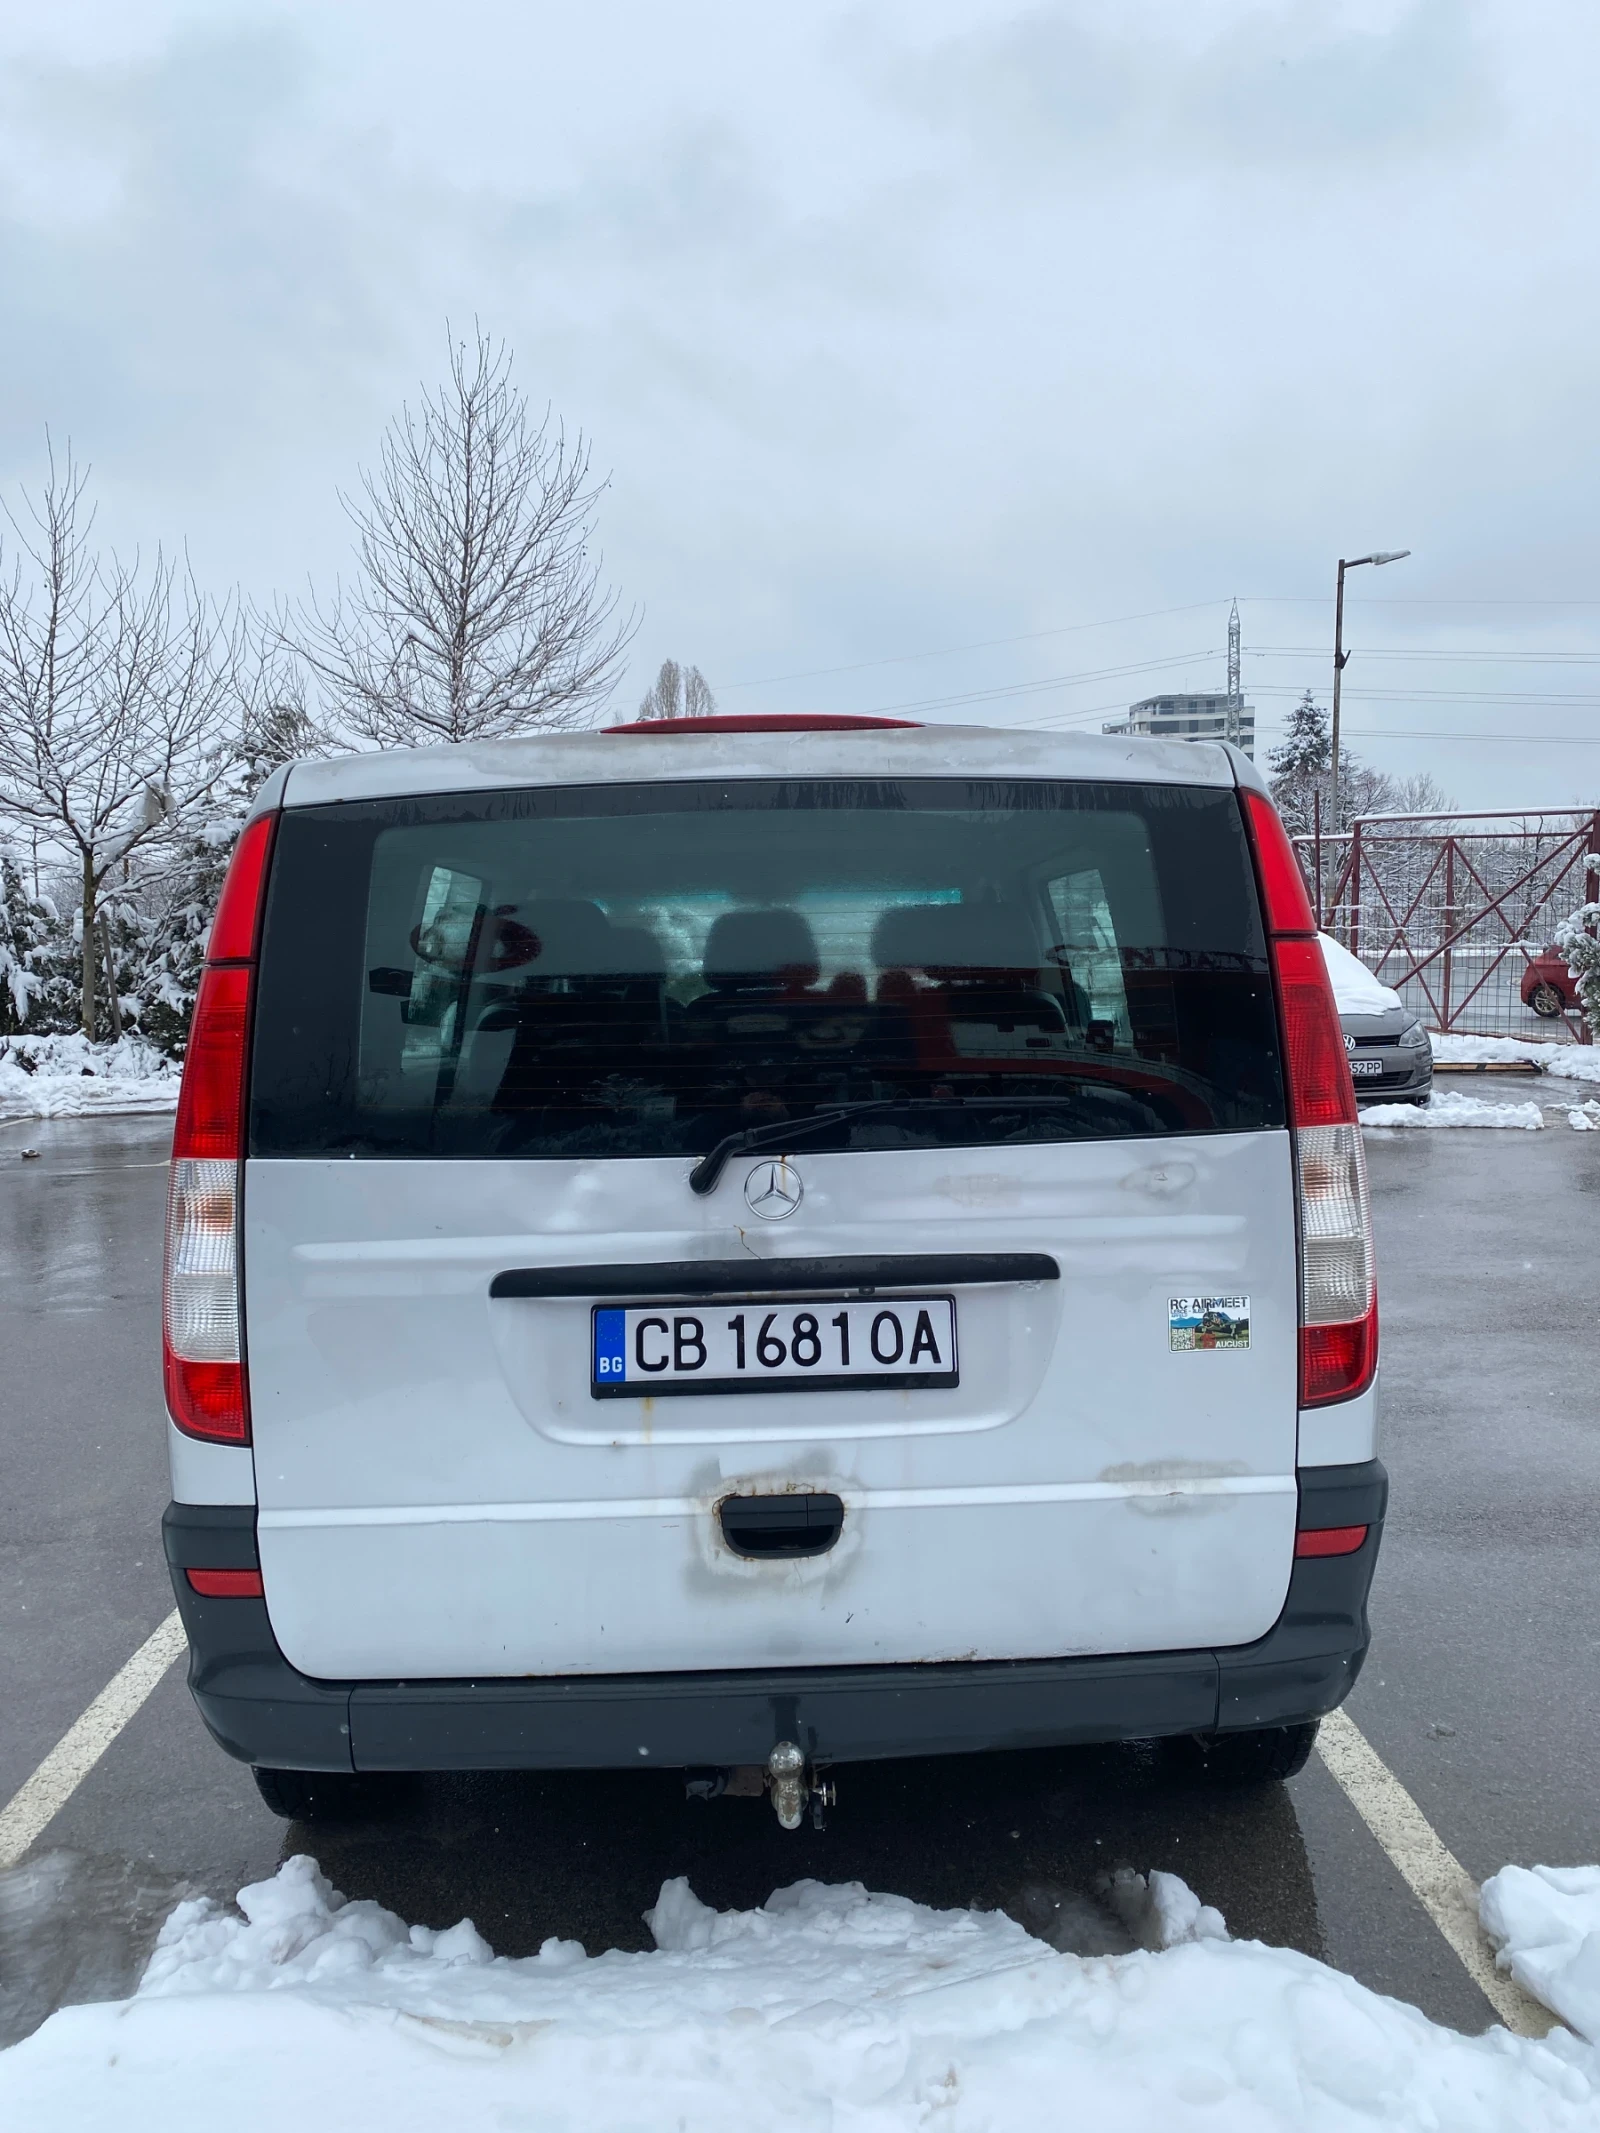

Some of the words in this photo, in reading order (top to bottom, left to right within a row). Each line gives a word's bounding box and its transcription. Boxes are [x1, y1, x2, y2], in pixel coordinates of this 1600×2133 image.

[1349, 1062, 1365, 1074] 52
[1367, 1062, 1381, 1074] PP
[1170, 1299, 1188, 1310] RC
[1192, 1297, 1248, 1309] AIRMEET
[635, 1316, 708, 1373] CB
[727, 1311, 850, 1370] 1681
[1215, 1340, 1249, 1348] AUGUST
[599, 1356, 623, 1374] BG
